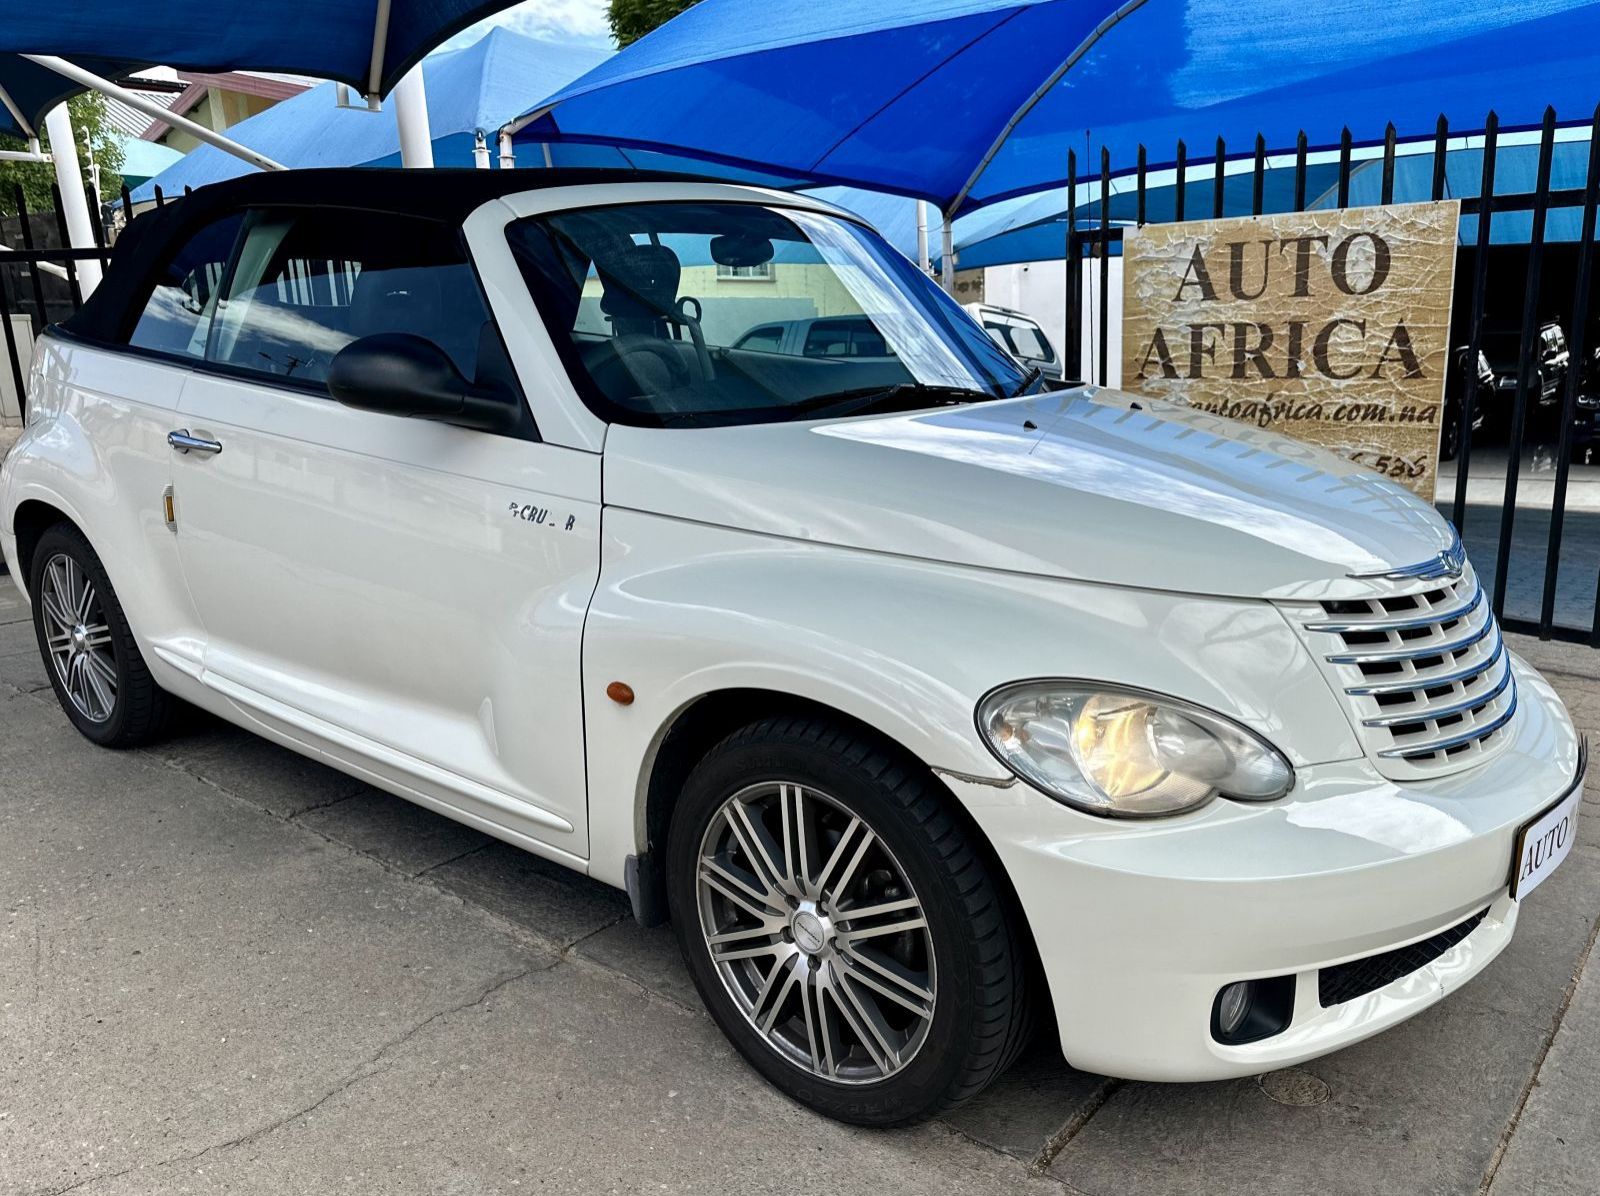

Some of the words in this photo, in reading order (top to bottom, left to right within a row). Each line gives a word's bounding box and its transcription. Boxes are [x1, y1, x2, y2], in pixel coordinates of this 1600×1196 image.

[1170, 230, 1392, 303] AUTO
[1134, 316, 1428, 381] AFRICA
[1519, 816, 1568, 882] AUTO
